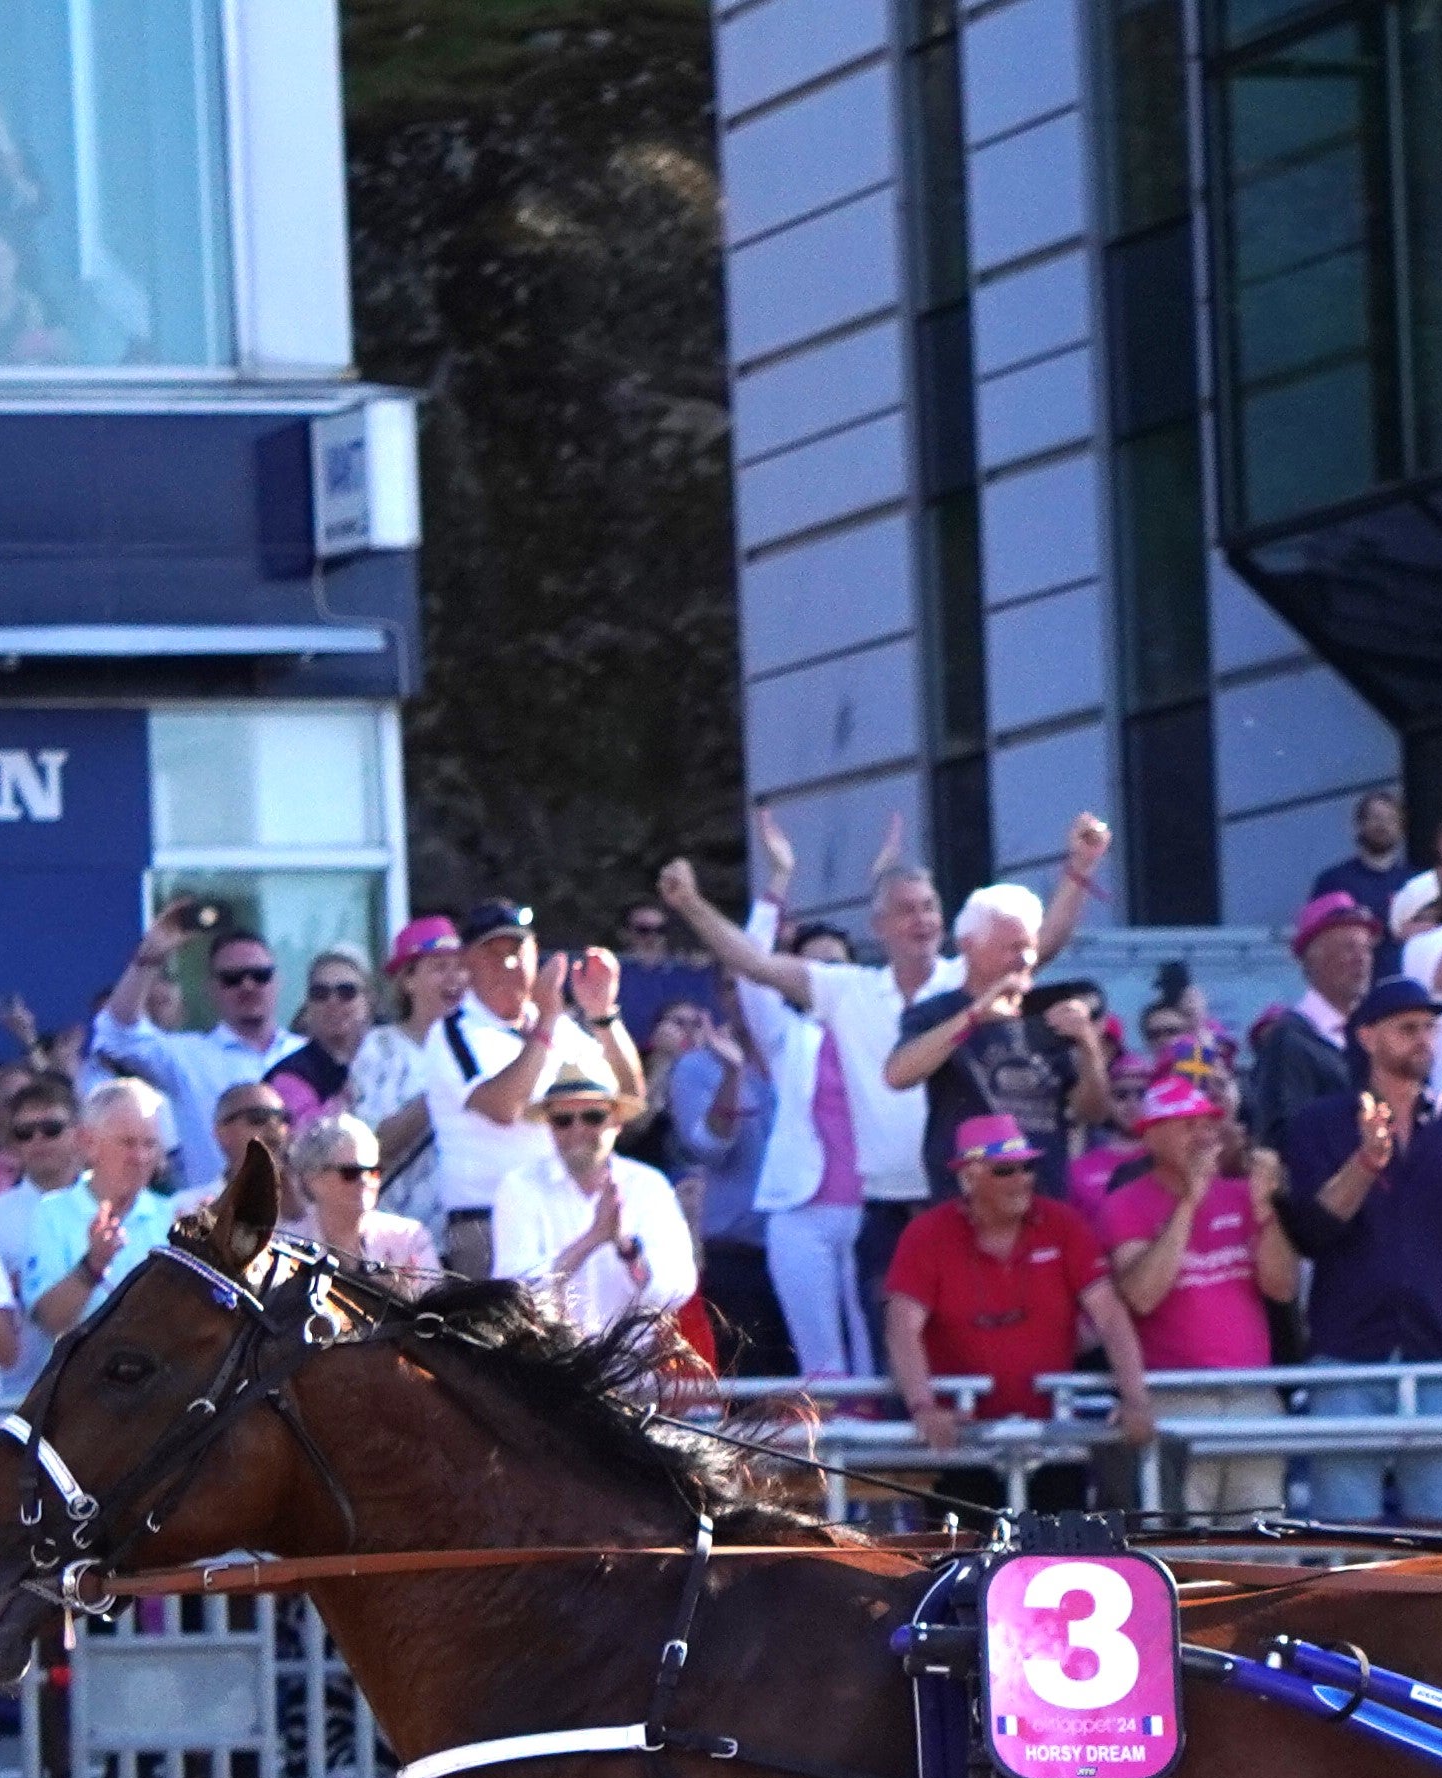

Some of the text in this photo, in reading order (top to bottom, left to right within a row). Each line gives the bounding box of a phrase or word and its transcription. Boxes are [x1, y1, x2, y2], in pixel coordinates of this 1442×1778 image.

[1023, 1561, 1139, 1710] 3
[1025, 1745, 1146, 1762] HORSY DREAM
